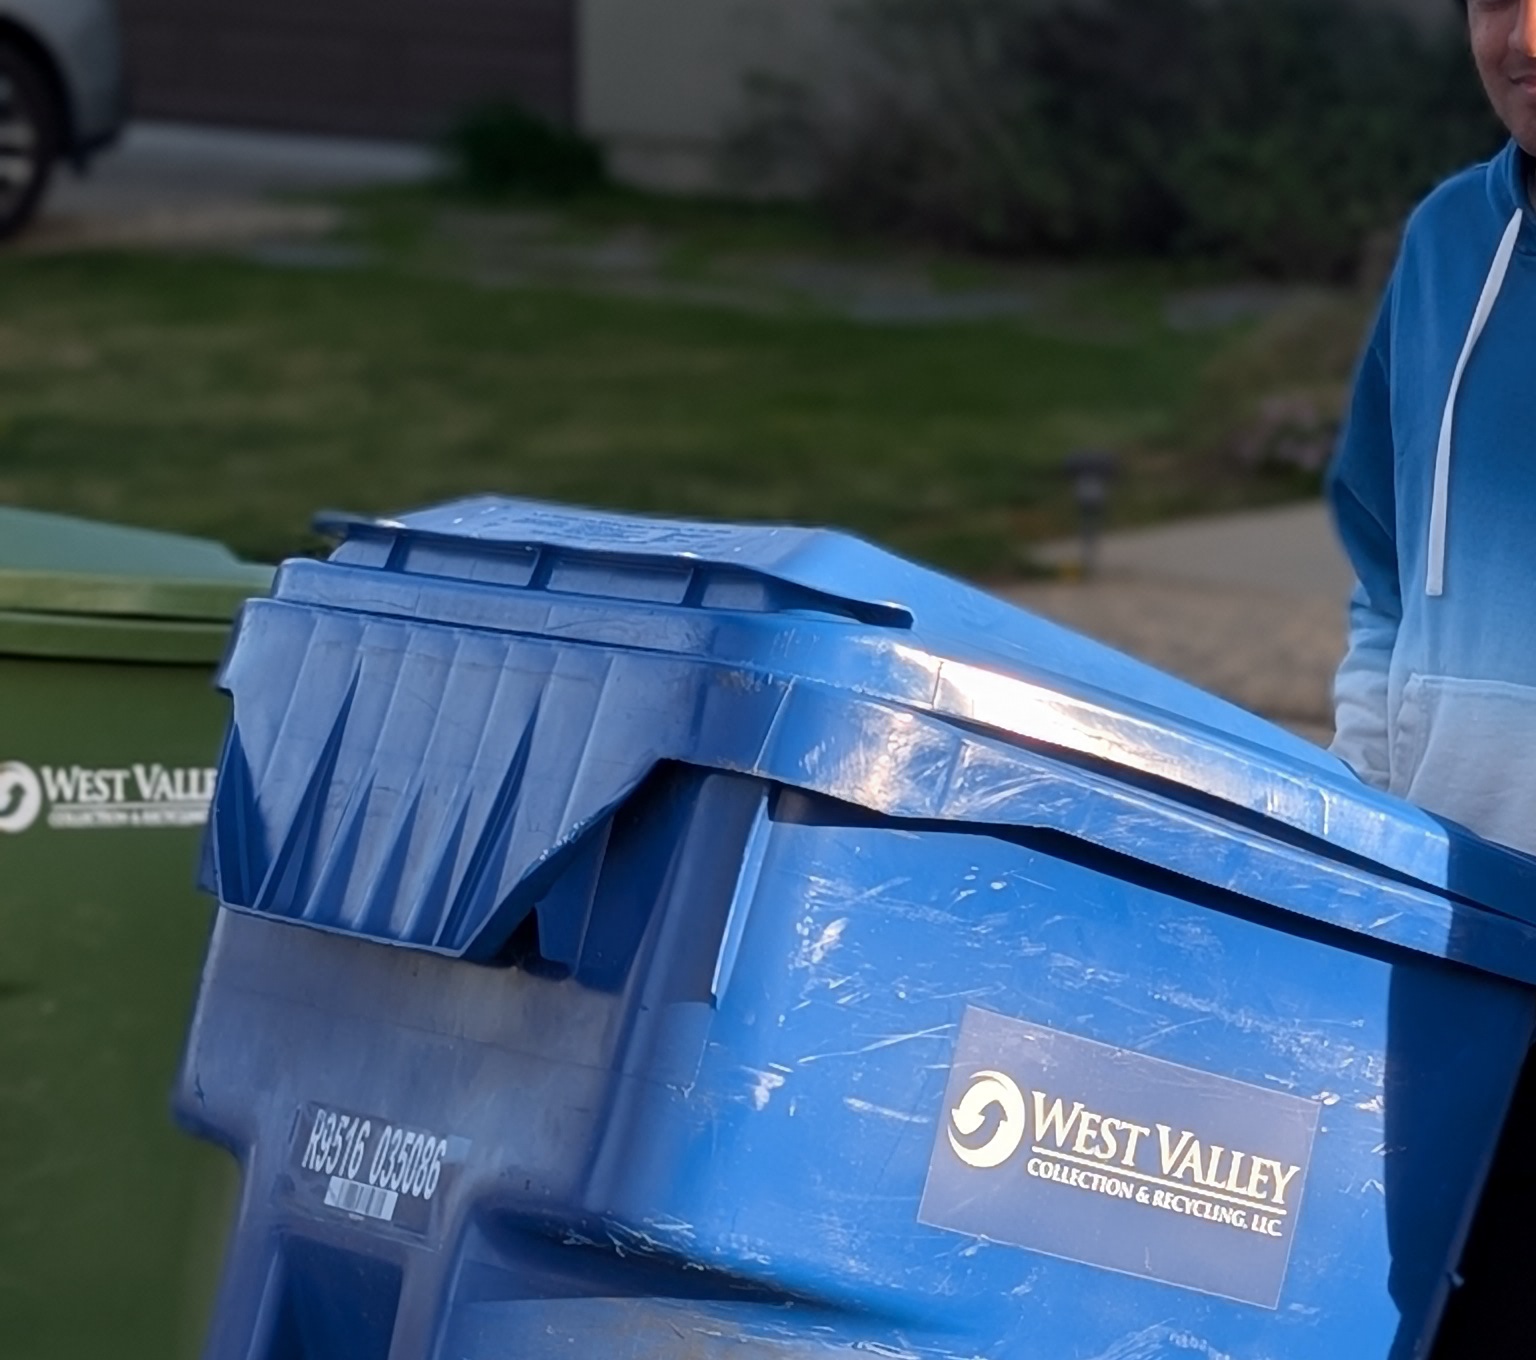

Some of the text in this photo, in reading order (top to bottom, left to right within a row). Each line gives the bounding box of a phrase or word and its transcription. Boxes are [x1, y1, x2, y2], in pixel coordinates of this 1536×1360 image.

[40, 764, 131, 802] WEST
[301, 1108, 447, 1200] R9516 035086
[1031, 1090, 1300, 1205] WEST VALLEY
[1027, 1157, 1283, 1237] COLLECTION & RECYCLING, LLC
